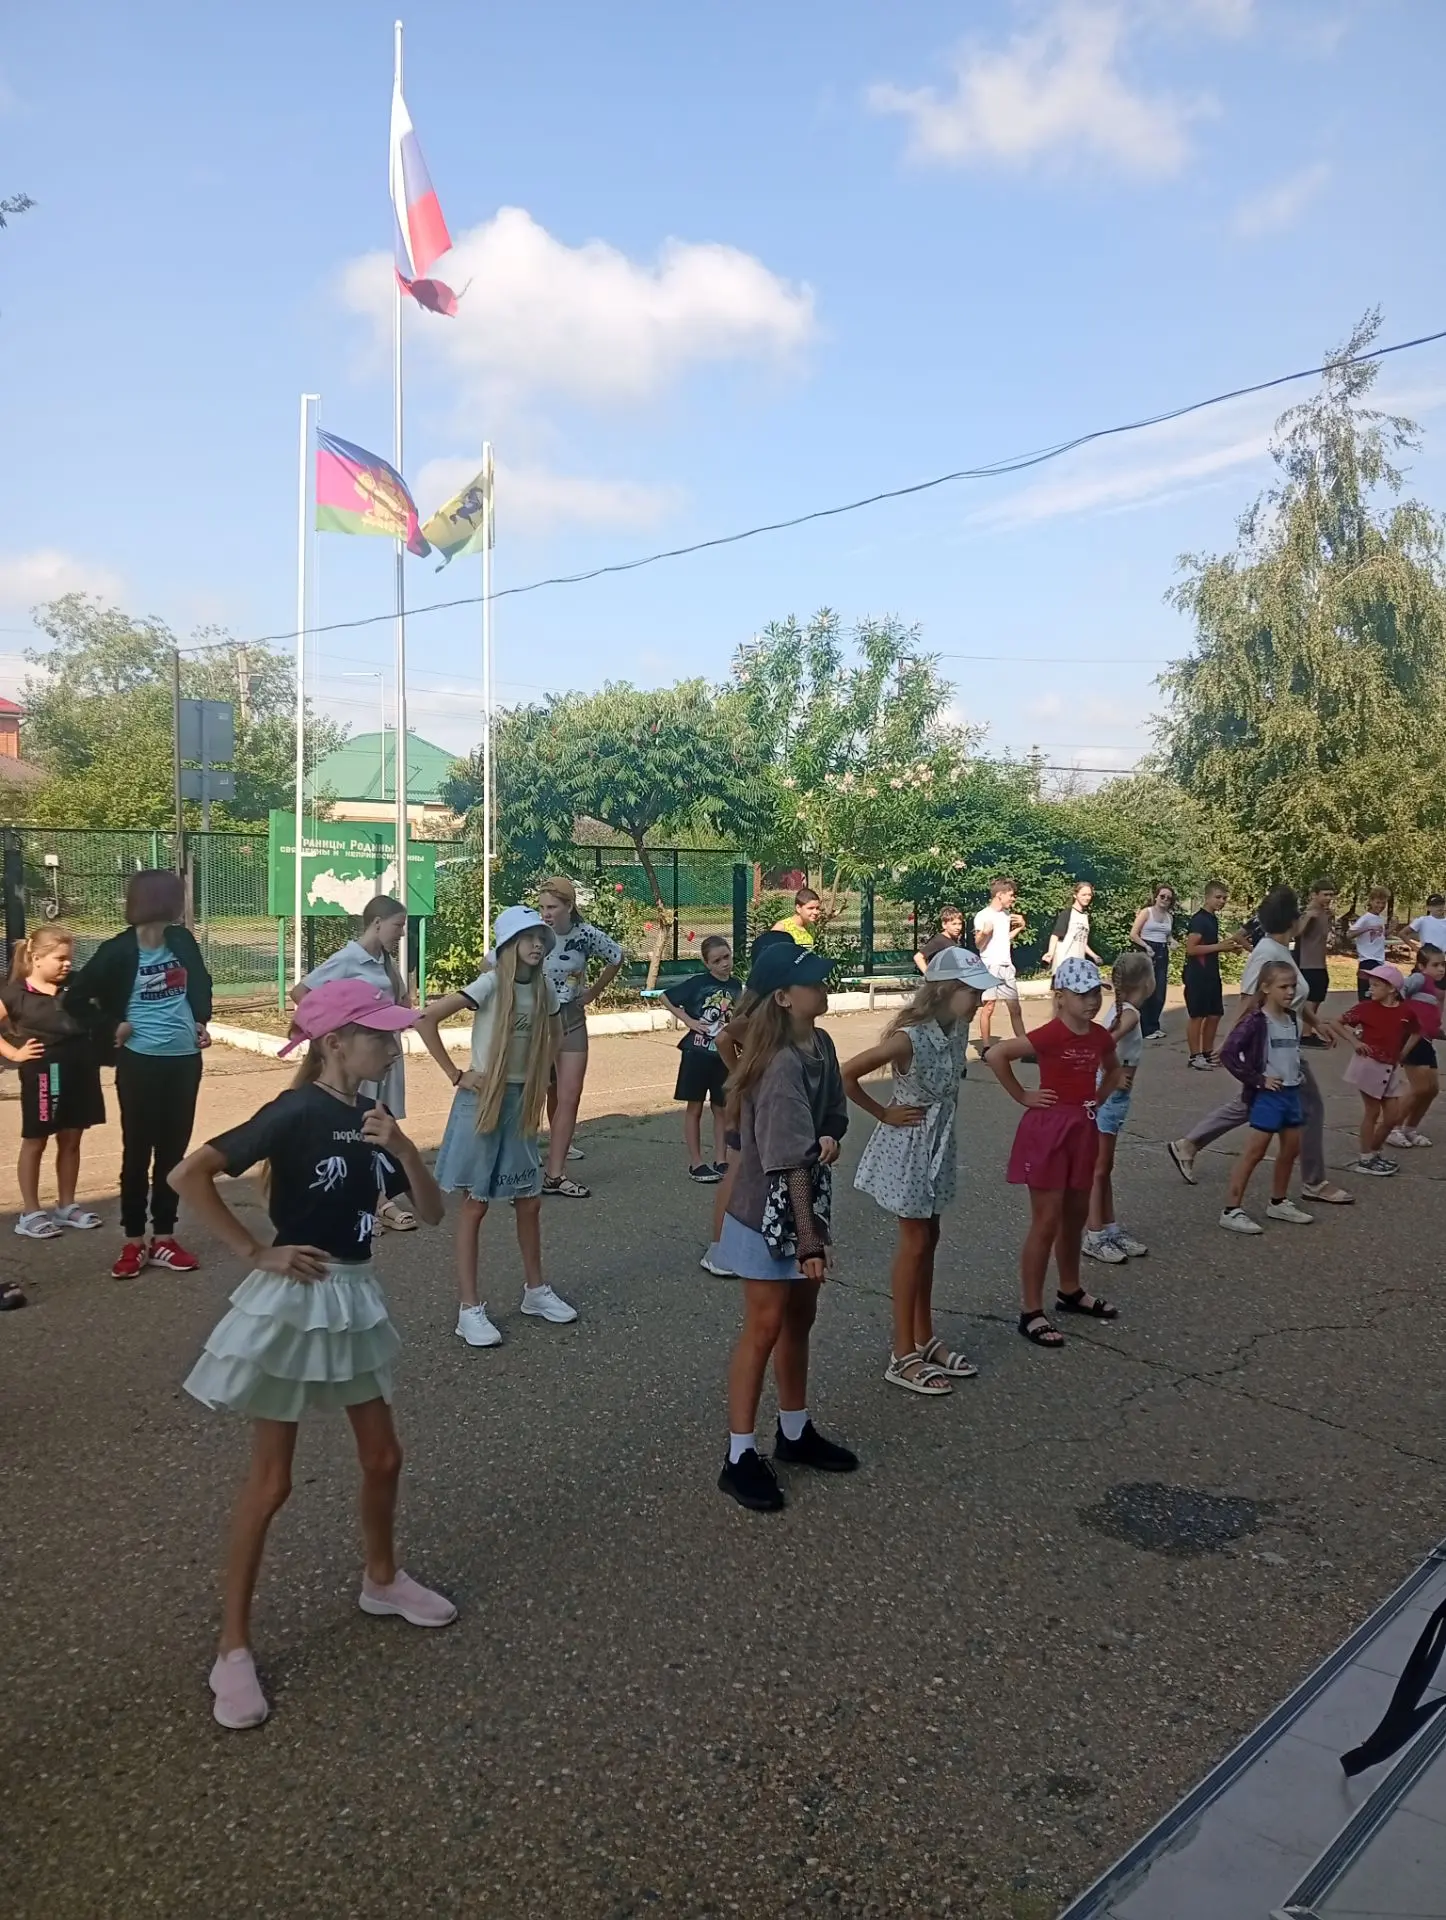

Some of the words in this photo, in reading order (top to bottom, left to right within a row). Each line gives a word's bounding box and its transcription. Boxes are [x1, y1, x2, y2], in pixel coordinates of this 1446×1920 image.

[297, 836, 346, 850] РАНИЦЫ
[141, 959, 182, 975] TOMMY
[142, 984, 185, 1000] HILFIGER
